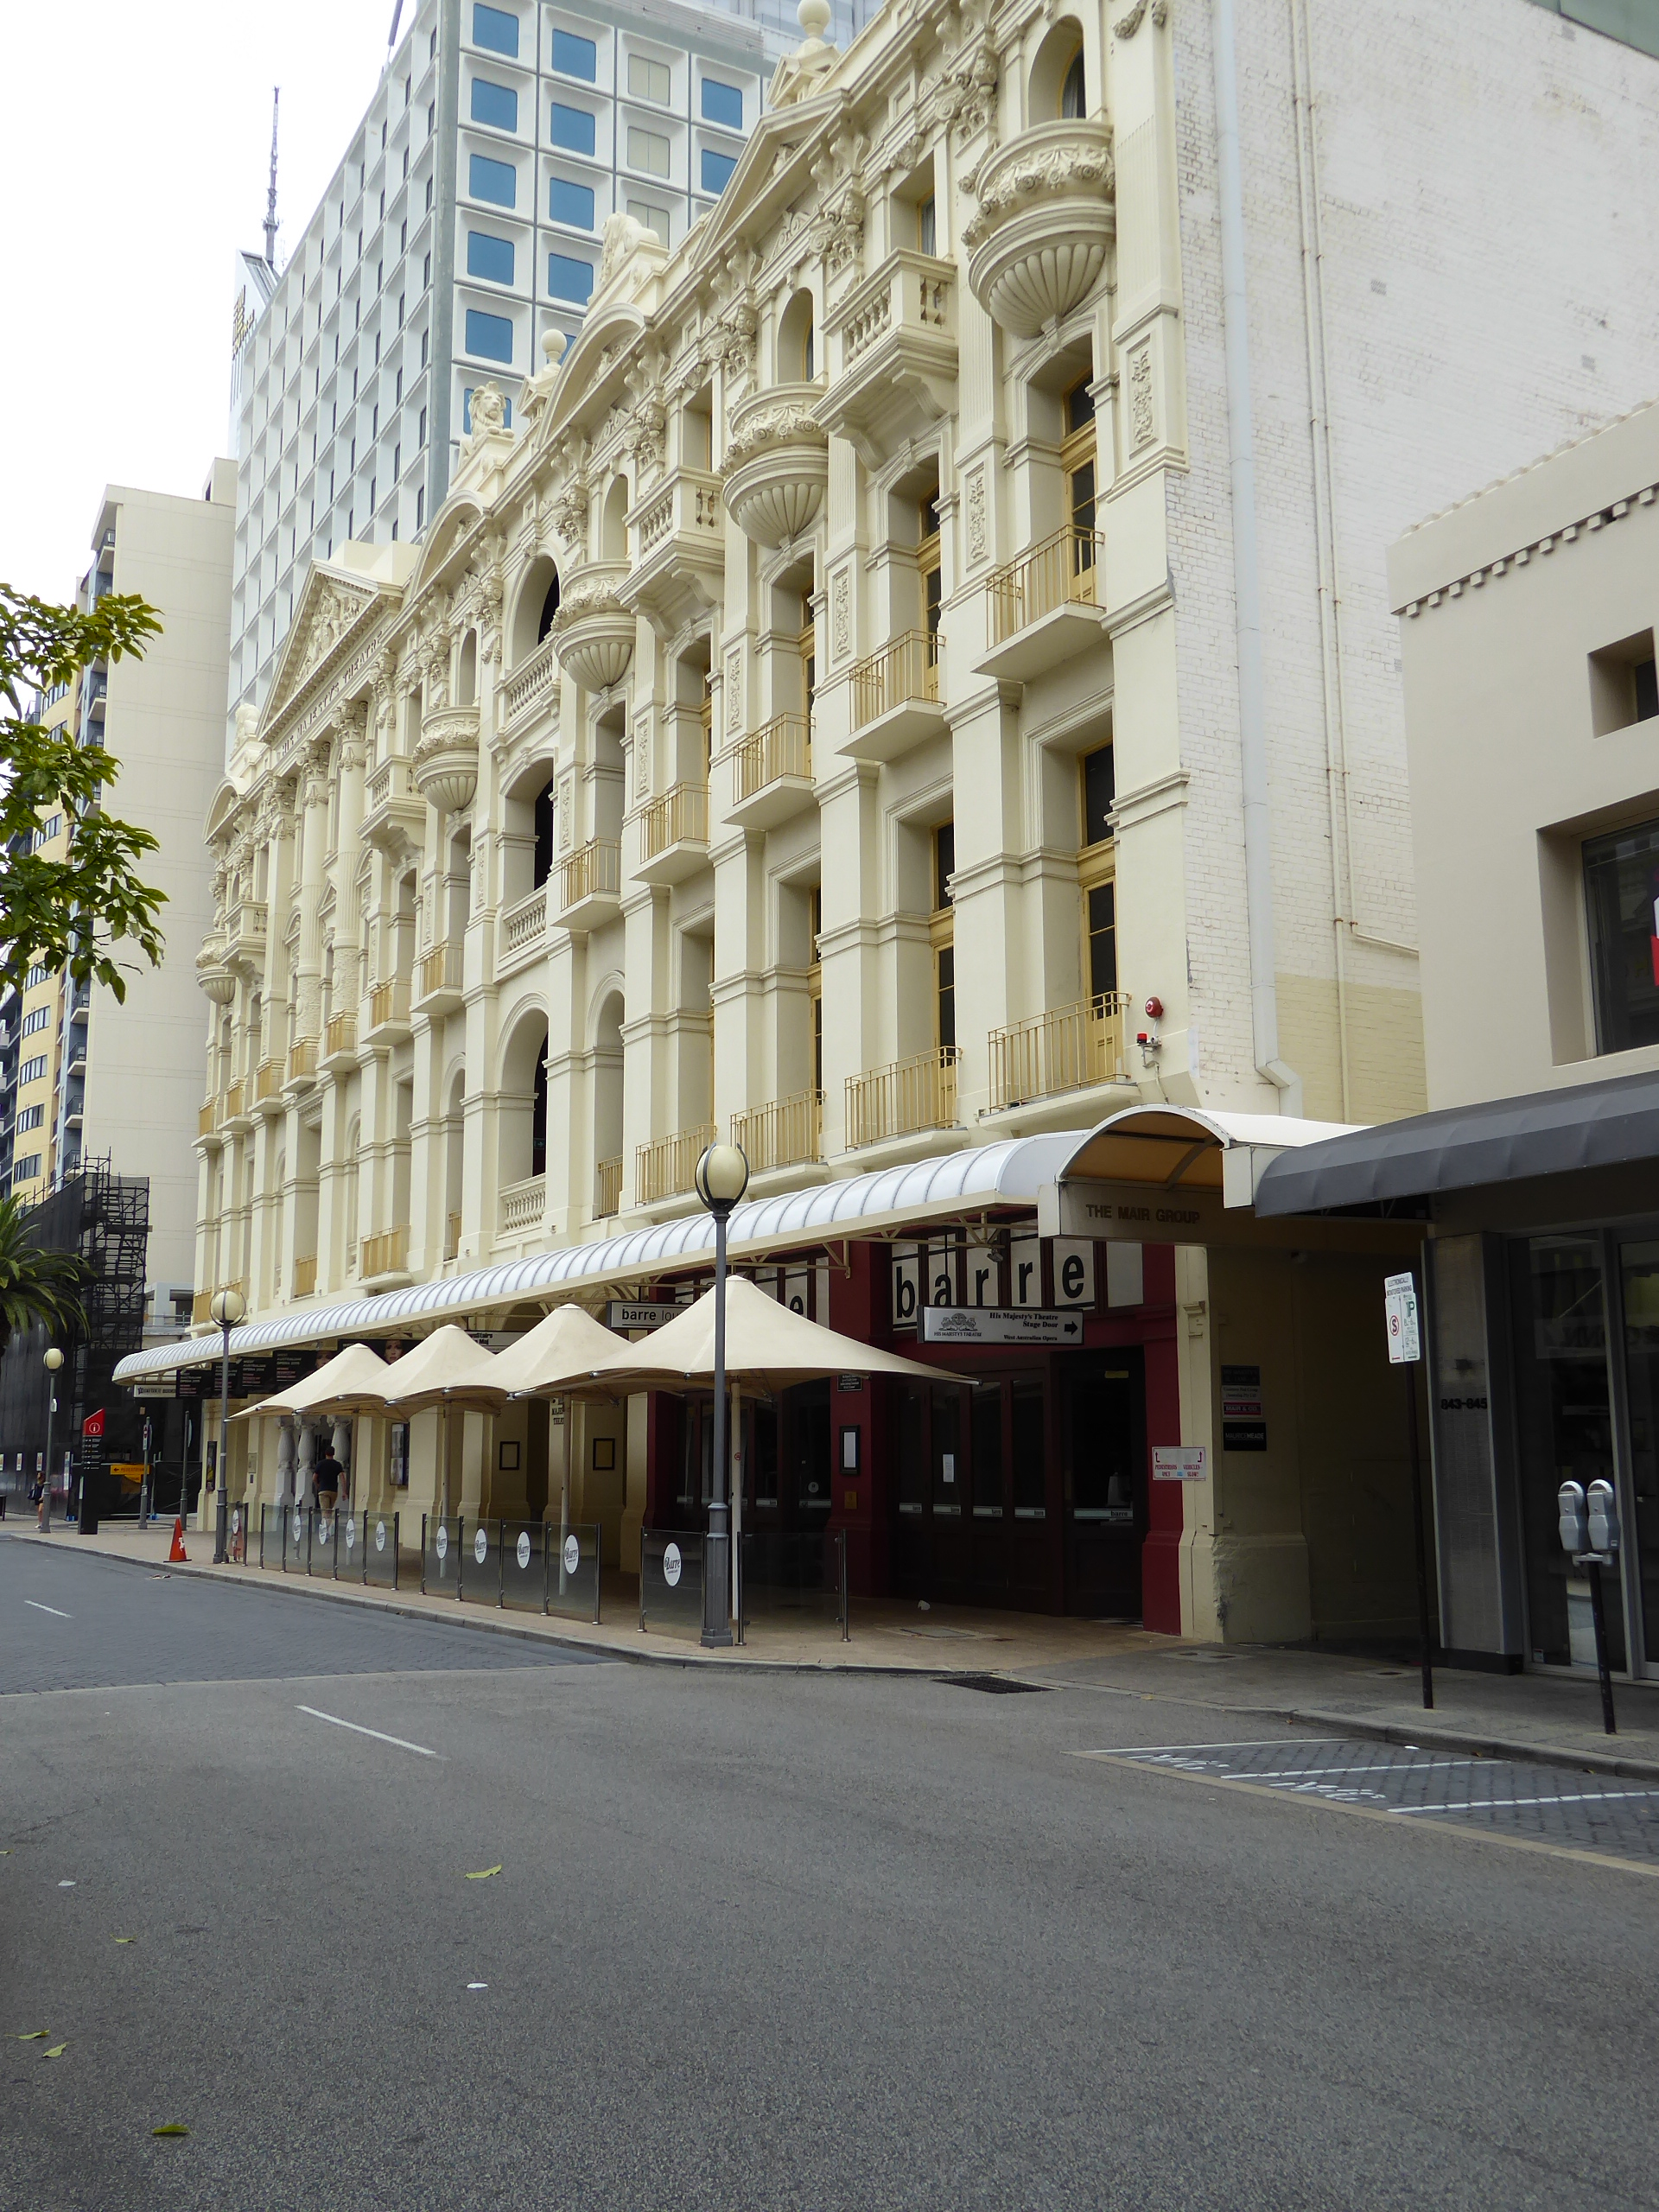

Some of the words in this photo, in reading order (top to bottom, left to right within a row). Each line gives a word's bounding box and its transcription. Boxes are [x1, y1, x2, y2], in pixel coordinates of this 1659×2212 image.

[1085, 1204, 1112, 1219] THE
[1118, 1206, 1150, 1222] MAIR
[1156, 1209, 1200, 1224] GROUP
[896, 1255, 1084, 1319] barre
[622, 1308, 657, 1320] barre
[1002, 1313, 1033, 1321] Majesty's
[1441, 1397, 1488, 1410] 843-845
[664, 1556, 681, 1571] Barre
